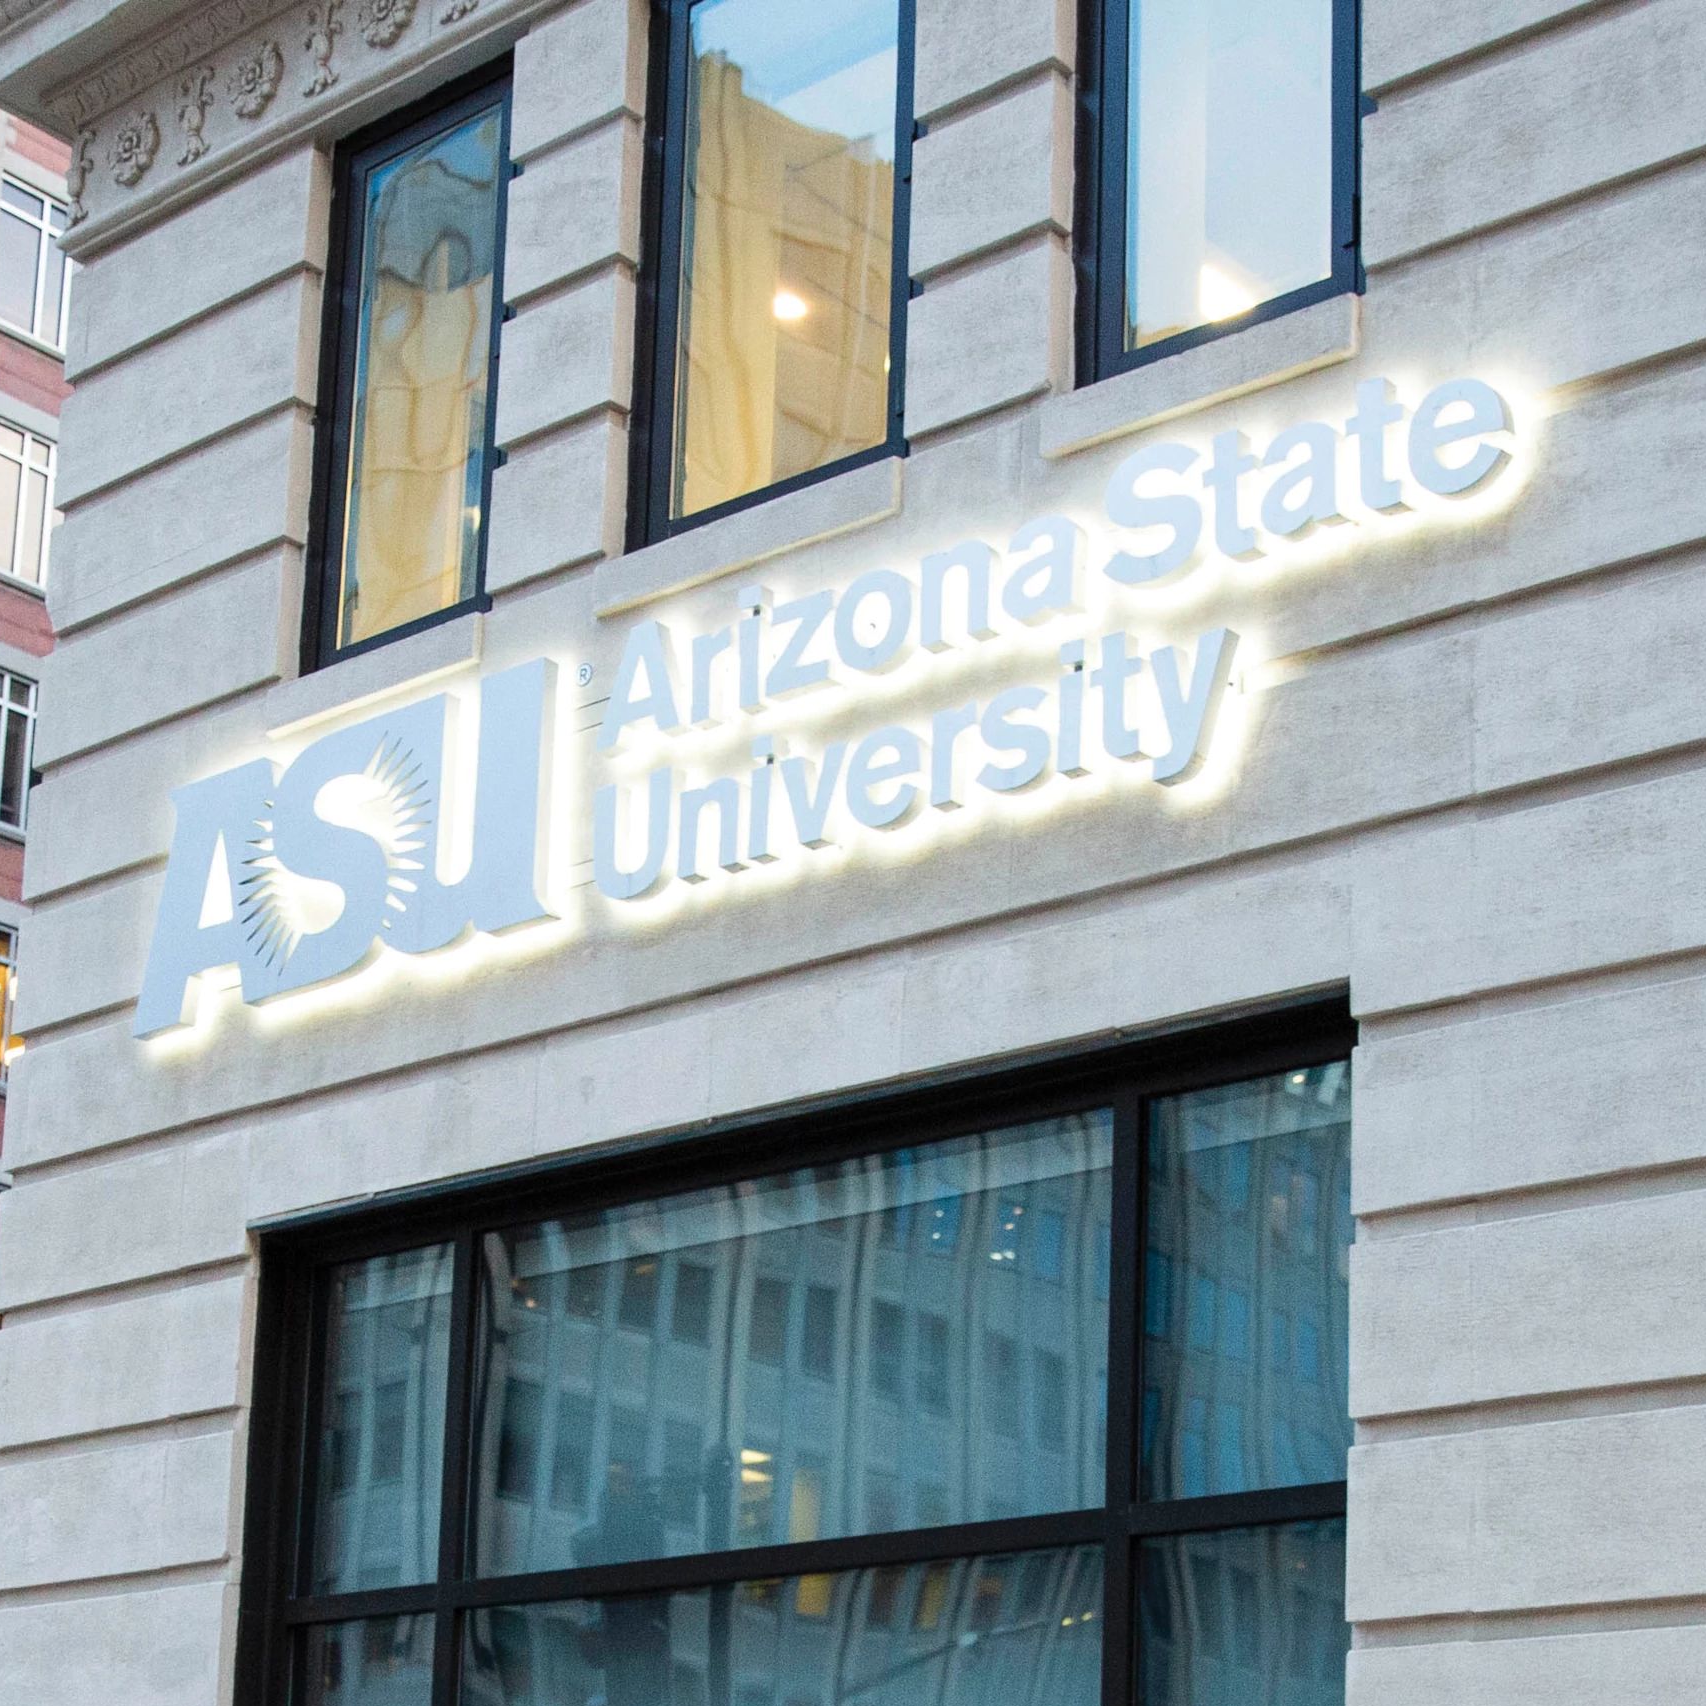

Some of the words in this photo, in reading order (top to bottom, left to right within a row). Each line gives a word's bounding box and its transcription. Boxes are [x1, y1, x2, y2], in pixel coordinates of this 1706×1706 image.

[595, 513, 1087, 752] Arizona
[1103, 376, 1517, 587] State
[131, 655, 561, 1043] ASU
[591, 626, 1241, 901] University
